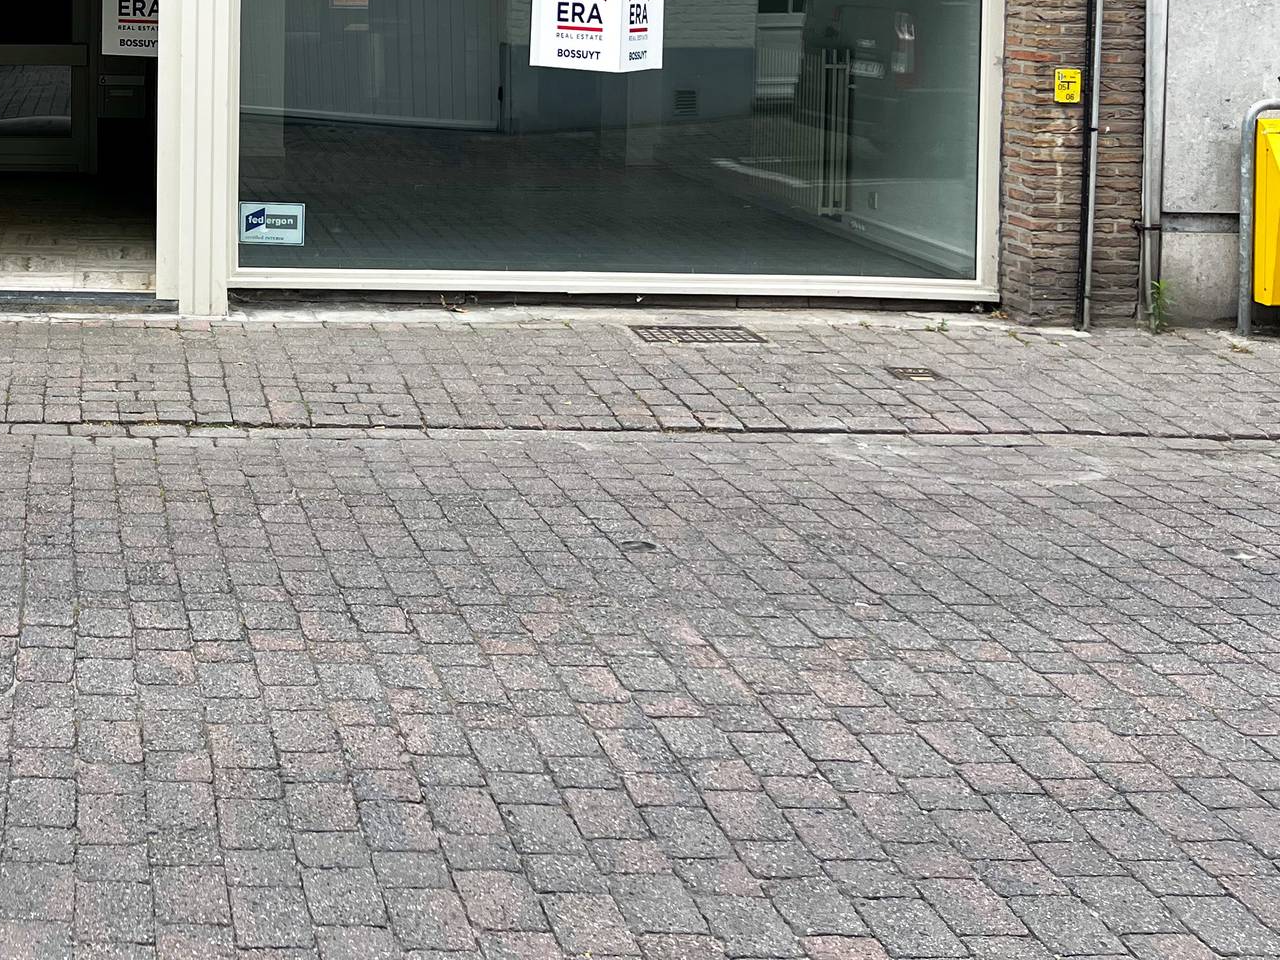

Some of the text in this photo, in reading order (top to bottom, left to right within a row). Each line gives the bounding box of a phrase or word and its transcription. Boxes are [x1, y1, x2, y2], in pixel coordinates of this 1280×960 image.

[557, 1, 603, 25] ERA
[629, 3, 648, 25] ERA
[556, 32, 603, 41] REAL ESTATE
[119, 39, 159, 48] BOSSUY
[557, 48, 601, 60] BOSSUYT
[629, 50, 647, 61] BOSSUYT
